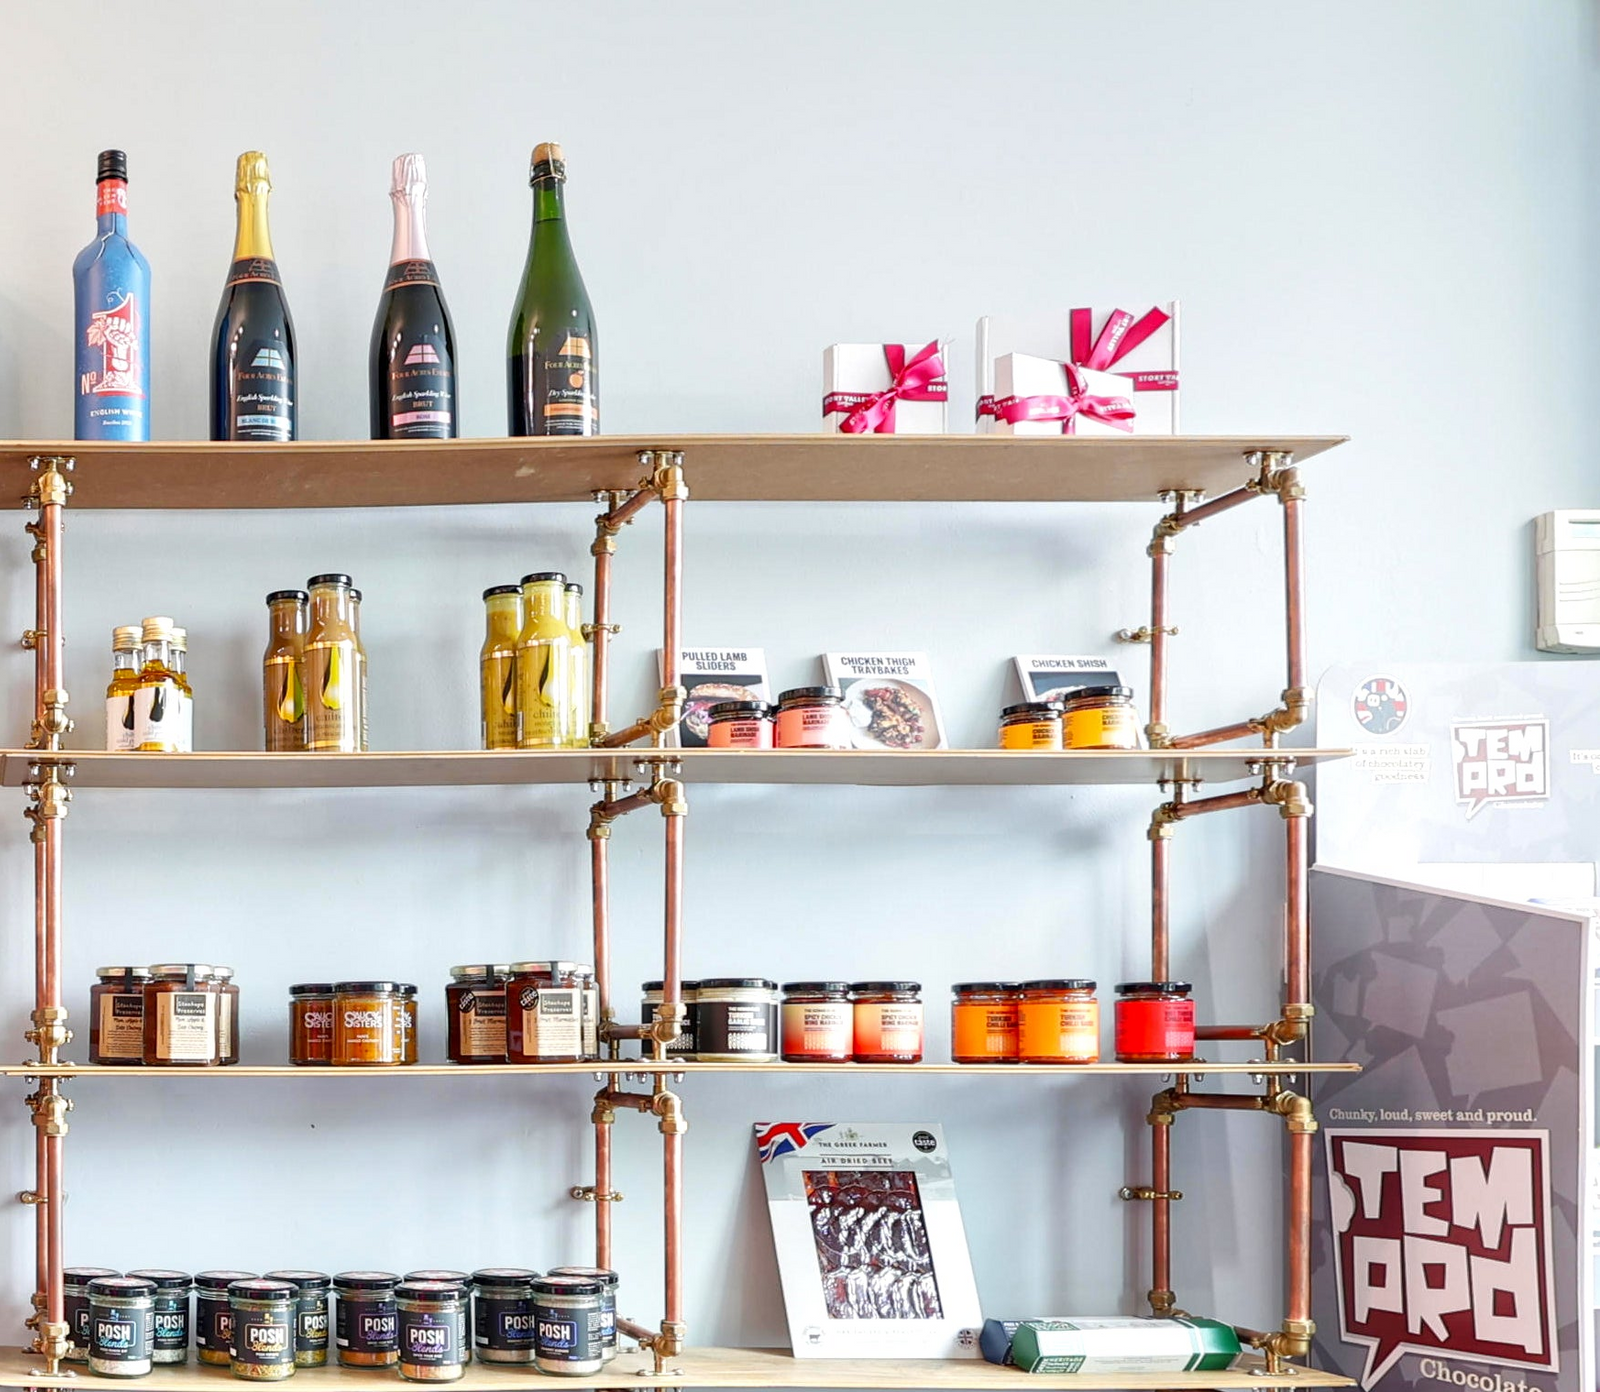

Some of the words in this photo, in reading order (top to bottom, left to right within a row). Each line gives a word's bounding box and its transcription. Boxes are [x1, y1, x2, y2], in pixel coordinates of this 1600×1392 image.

[682, 651, 718, 662] PULLED
[718, 651, 748, 662] LAMB
[840, 656, 883, 666] CHICKEN
[885, 657, 916, 667] THIGH
[1031, 659, 1075, 668] CHICKEN
[1077, 659, 1108, 668] SHISH
[695, 660, 737, 671] SLIDERS
[851, 665, 910, 675] TRAYBAKES
[1329, 1108, 1378, 1122] Chunky,
[1379, 1109, 1413, 1122] loud,
[1415, 1109, 1453, 1121] sweet
[1456, 1109, 1483, 1121] and
[1486, 1109, 1537, 1124] proud.
[155, 1315, 184, 1329] POSH
[364, 1317, 394, 1331] POSH
[504, 1315, 535, 1330] POSH
[98, 1323, 131, 1340] POSH
[250, 1328, 284, 1344] POSH
[410, 1329, 444, 1345] POSH
[539, 1323, 570, 1340] POSH
